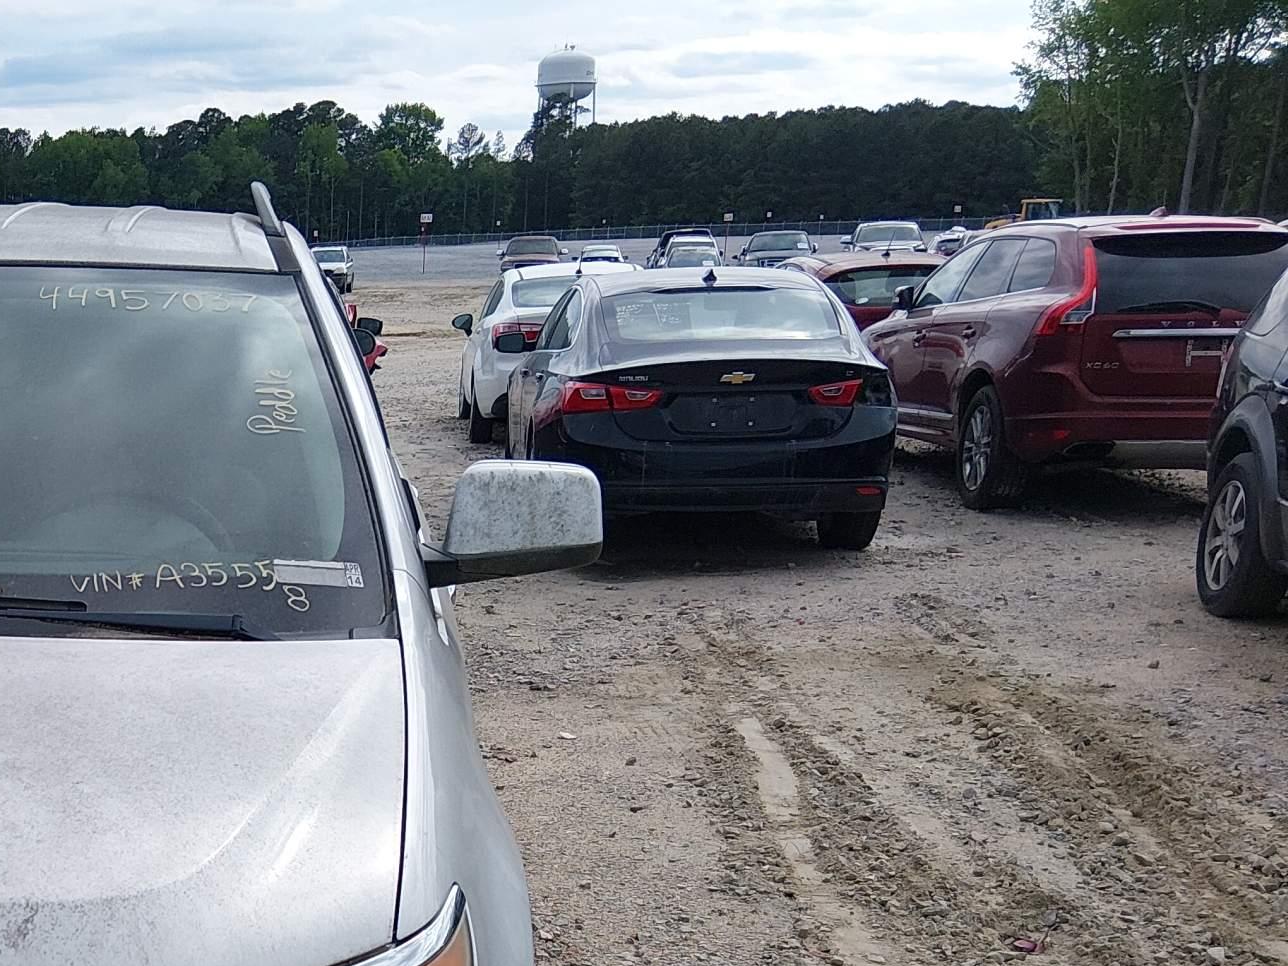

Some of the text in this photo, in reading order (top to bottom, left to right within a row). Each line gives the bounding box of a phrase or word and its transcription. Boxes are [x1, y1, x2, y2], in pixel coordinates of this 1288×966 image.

[39, 285, 257, 312] 44957037
[343, 562, 359, 574] APR
[70, 570, 143, 593] VIN#
[347, 574, 363, 586] 14
